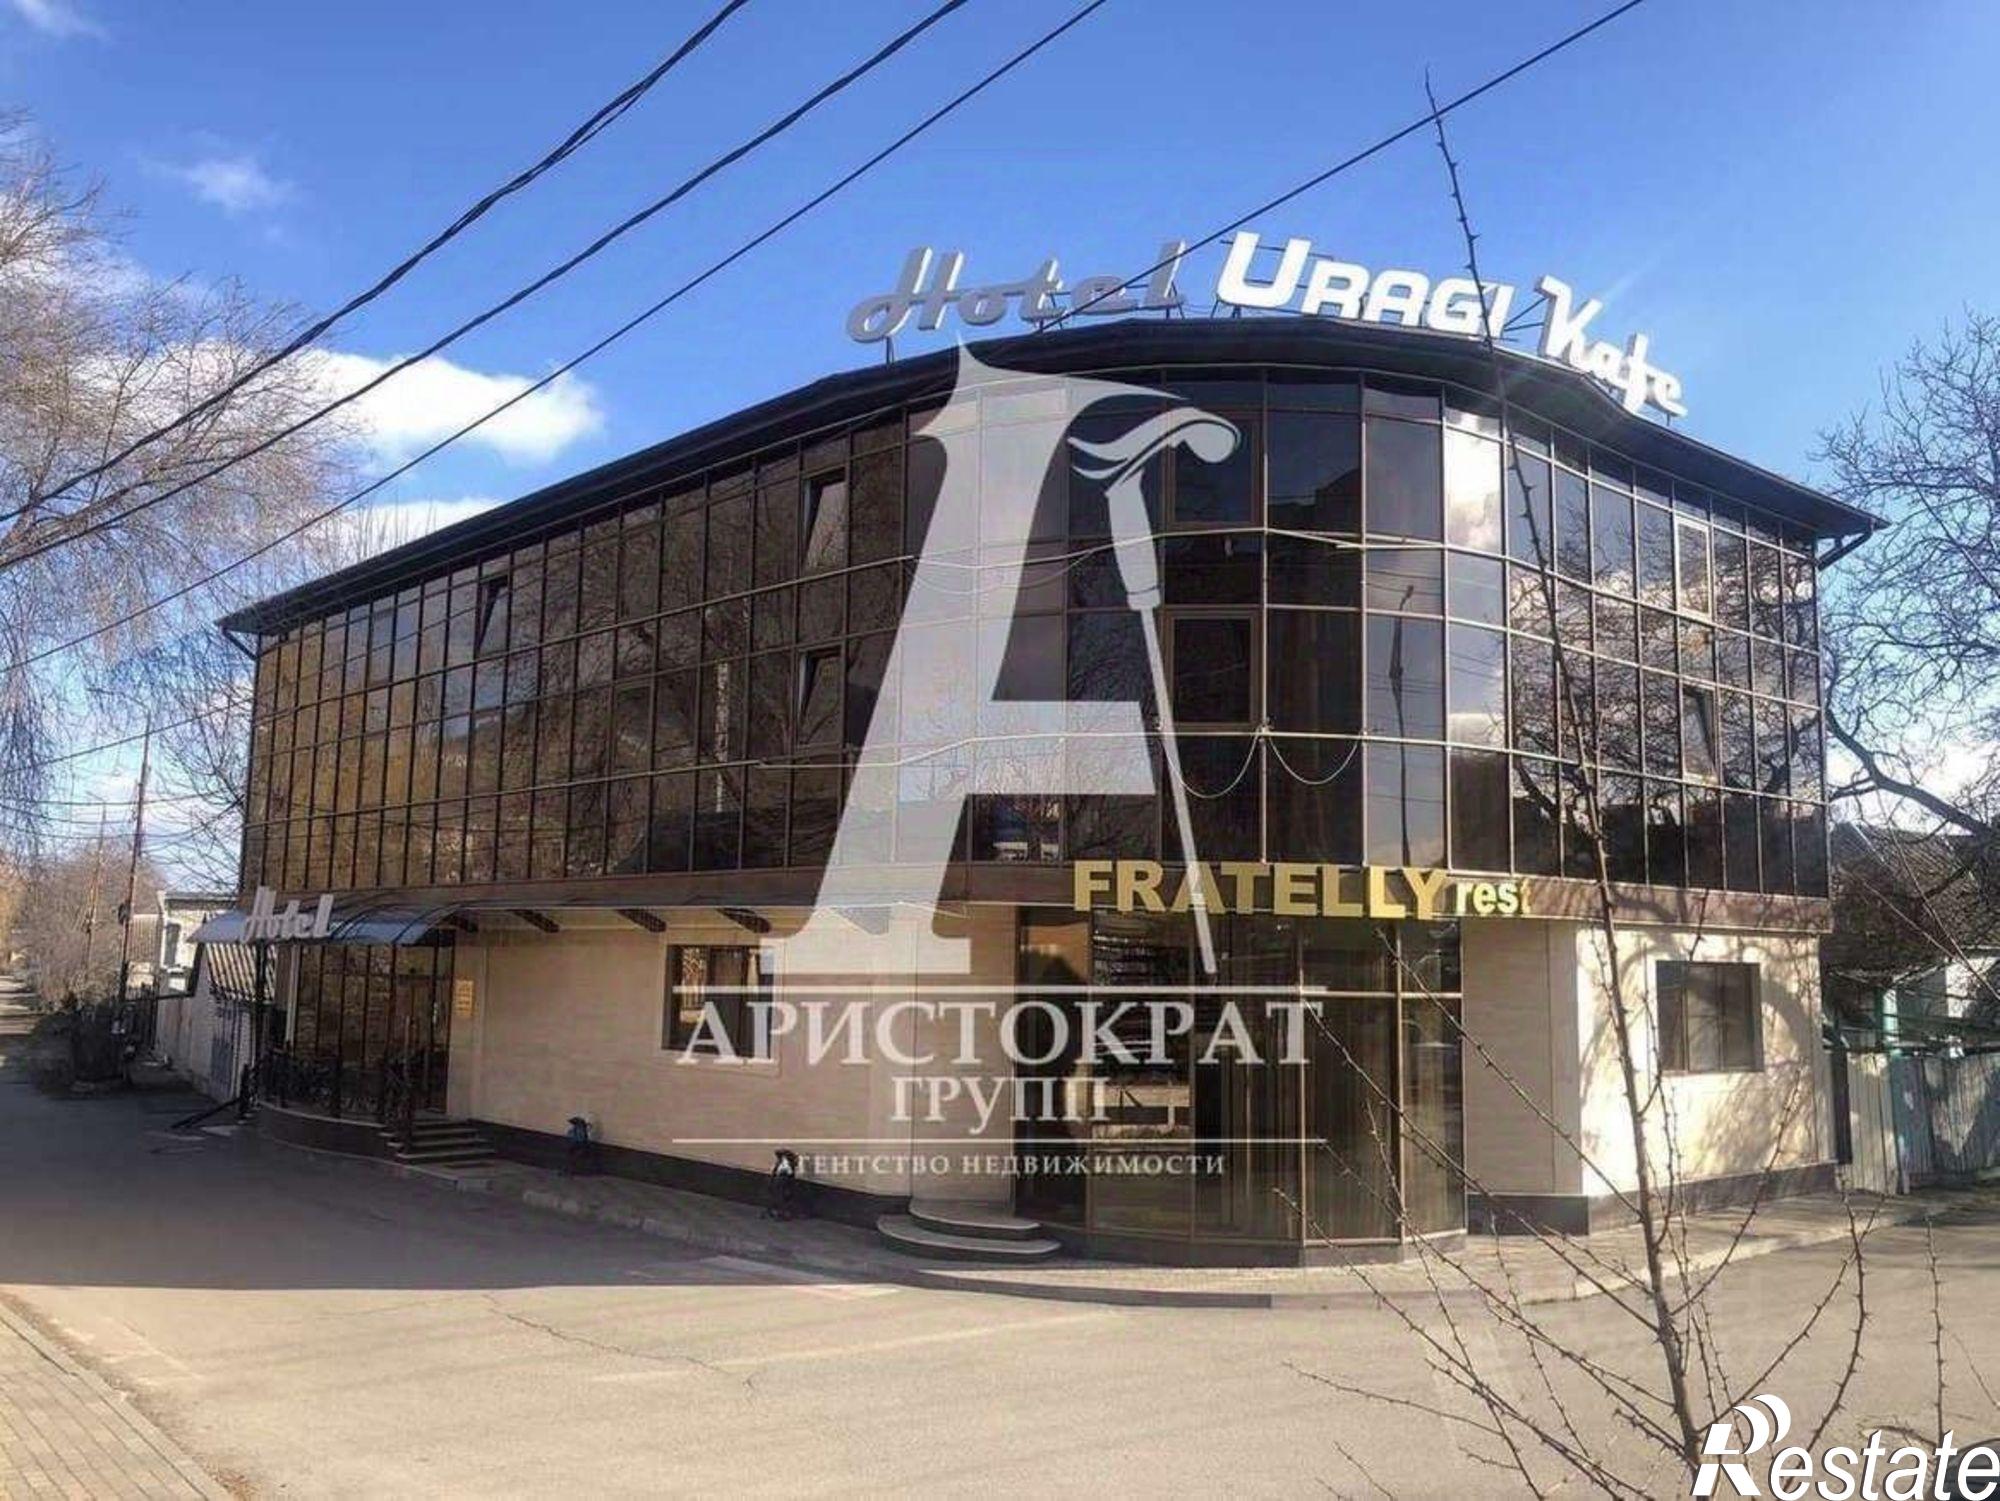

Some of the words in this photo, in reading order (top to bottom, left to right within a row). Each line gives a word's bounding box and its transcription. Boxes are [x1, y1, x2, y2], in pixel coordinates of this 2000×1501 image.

[847, 239, 1187, 343] Hotel
[1217, 231, 1514, 338] URAGI
[243, 885, 334, 942] Hotel
[1073, 860, 1449, 920] FRATELLY
